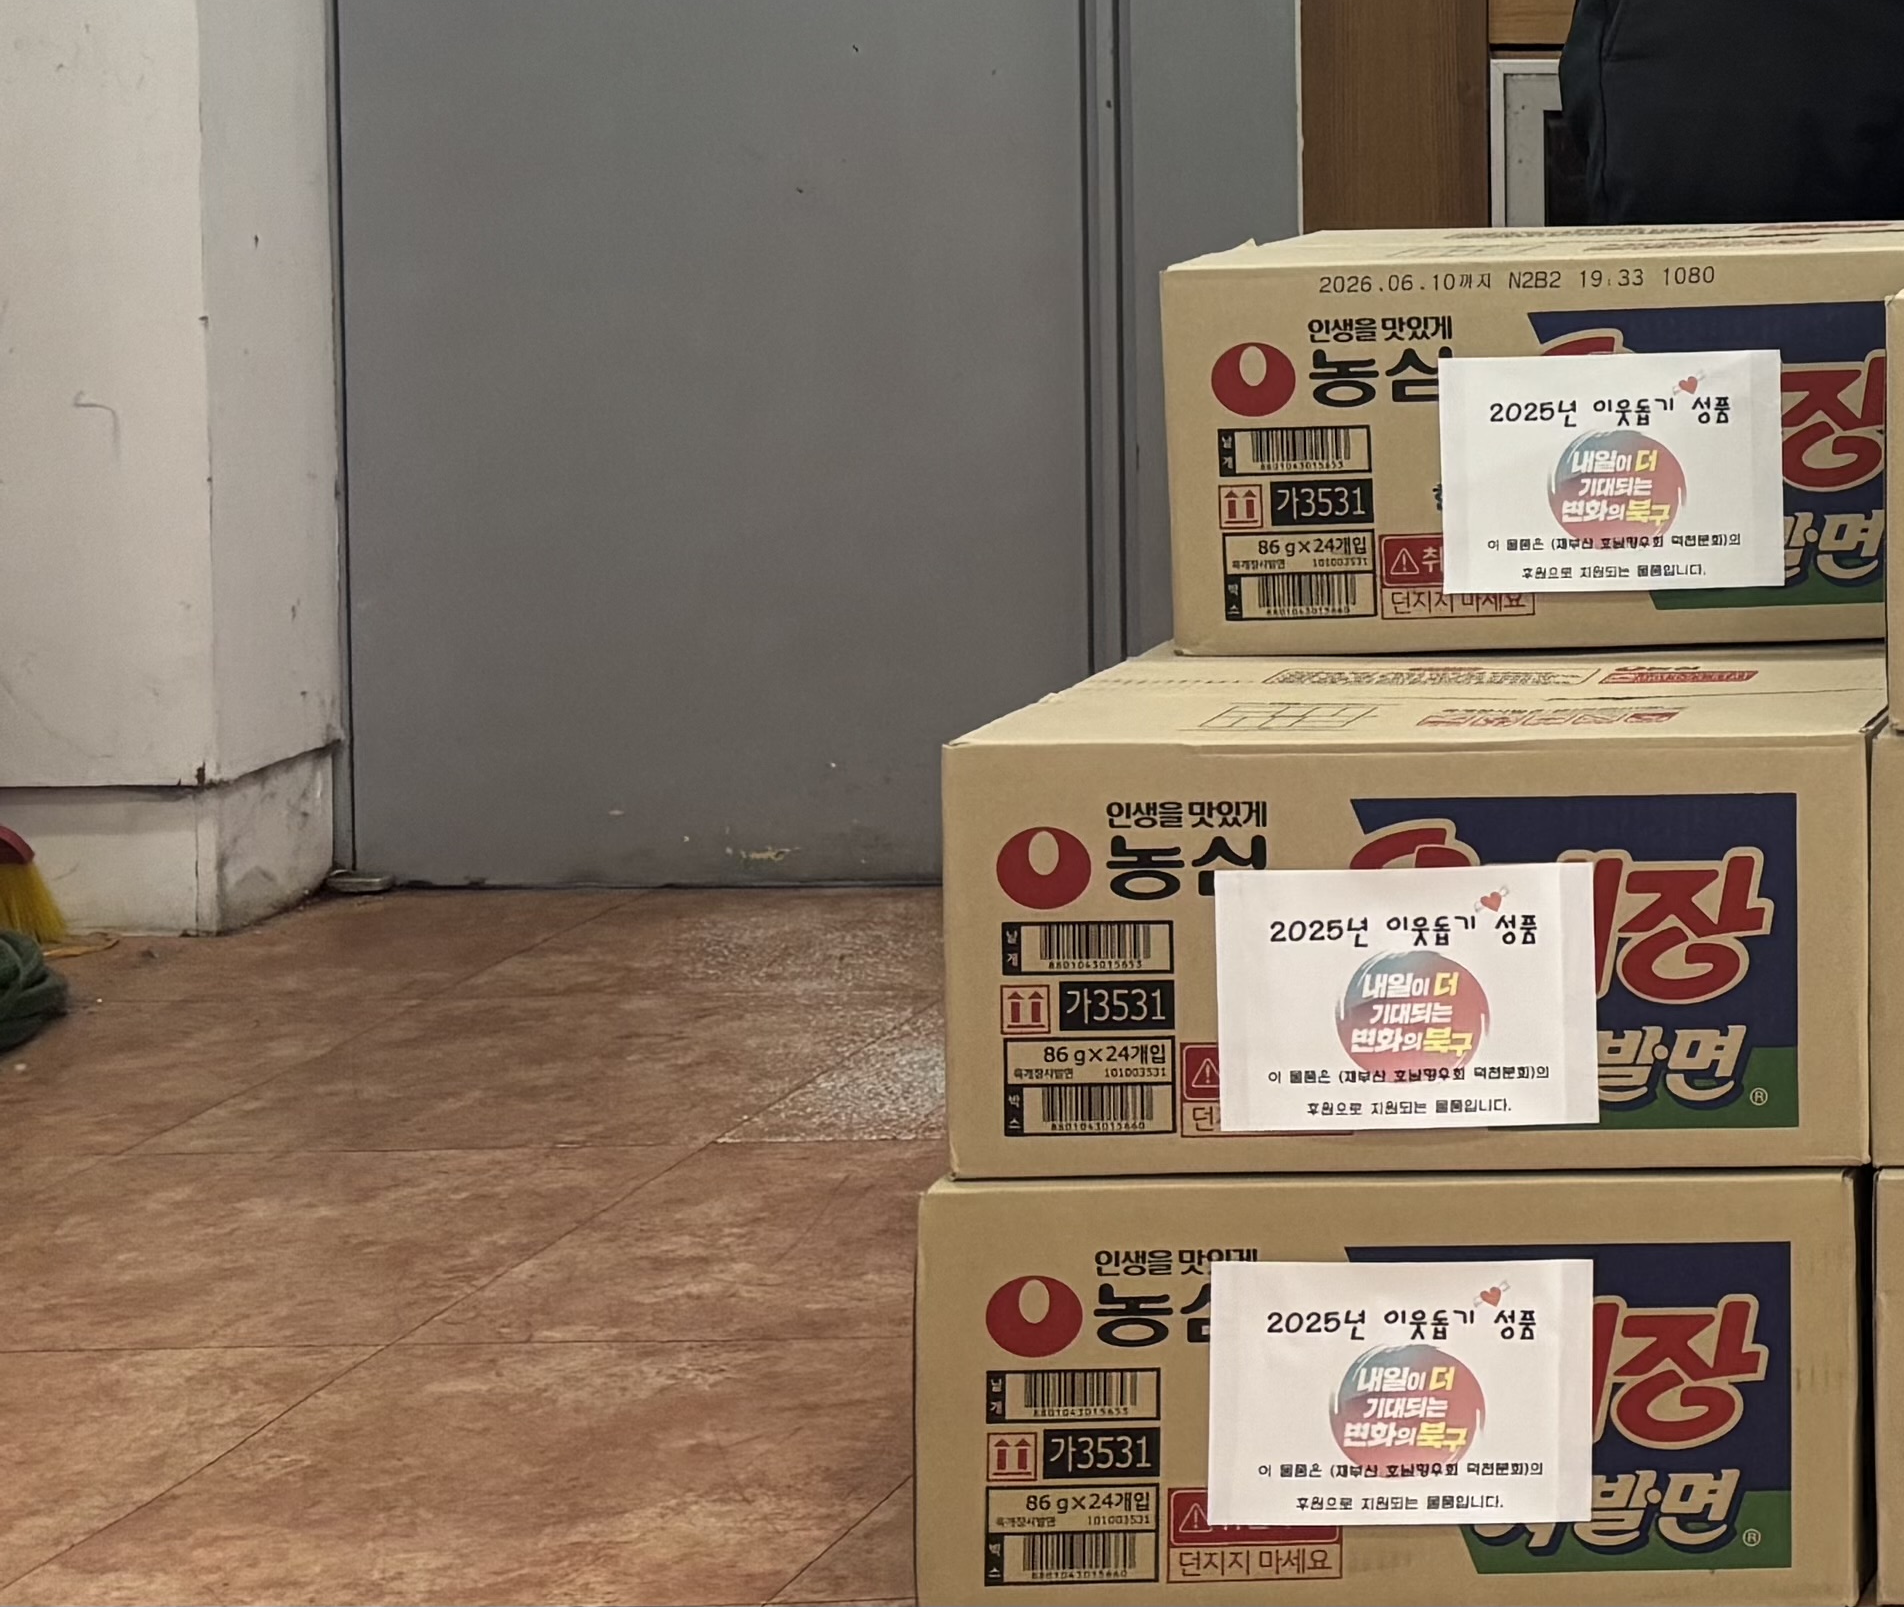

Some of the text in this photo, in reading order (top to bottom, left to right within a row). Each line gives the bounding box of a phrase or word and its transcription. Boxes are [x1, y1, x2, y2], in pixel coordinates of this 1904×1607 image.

[1509, 271, 1561, 289] N2B2
[1581, 269, 1643, 288] 19:33
[1664, 266, 1714, 285] 1080
[1490, 397, 1730, 427] 2025년 이웃돕기 성품
[1278, 487, 1365, 519] 가3531
[1107, 801, 1266, 828] 인생을 맛있게
[1271, 915, 1537, 947] 2025년 이웃돕기 성품
[1067, 988, 1165, 1024] 가3531
[1050, 1436, 1151, 1472] 가3531
